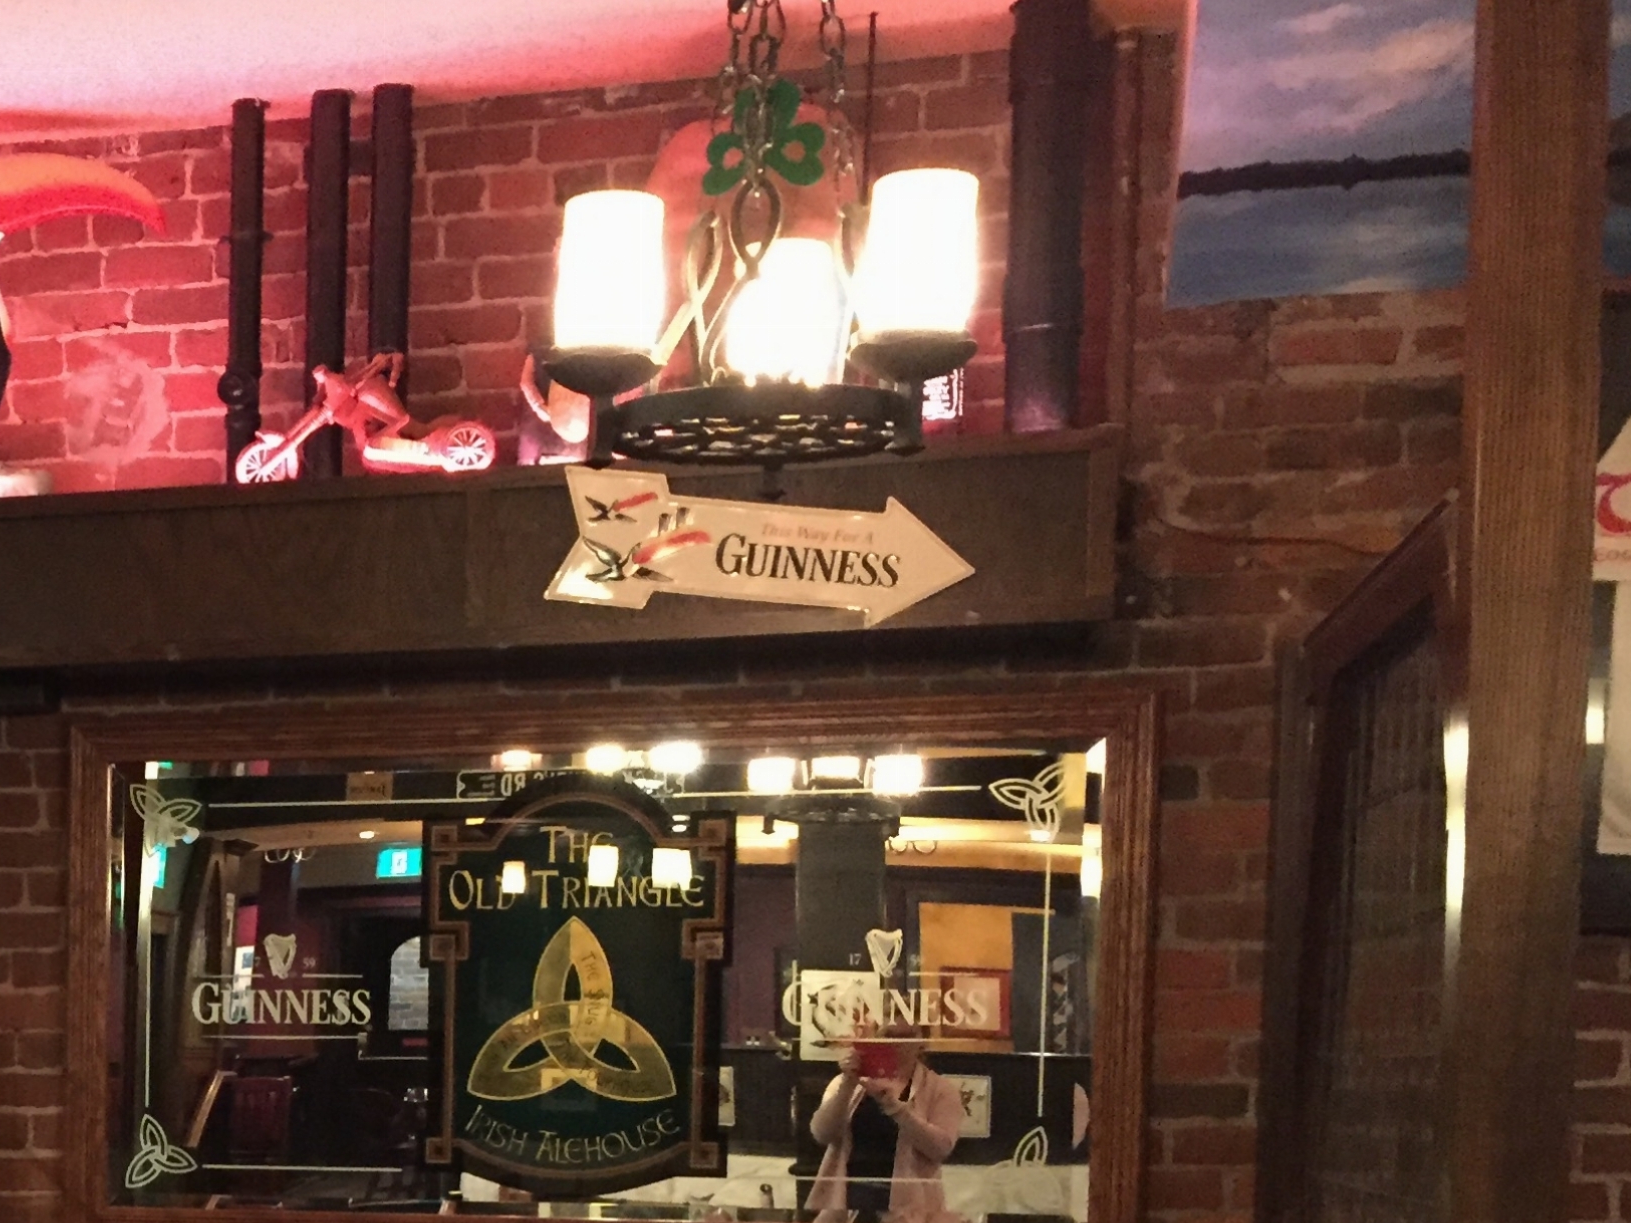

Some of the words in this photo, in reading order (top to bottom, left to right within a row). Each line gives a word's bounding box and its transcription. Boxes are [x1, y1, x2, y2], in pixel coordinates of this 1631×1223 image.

[797, 525, 828, 543] Way
[834, 529, 860, 543] For
[714, 532, 901, 589] GUINNESS
[531, 869, 705, 910] TRIANGLE
[191, 981, 372, 1026] GUINNESS
[465, 1104, 529, 1157] IRISH
[535, 1108, 681, 1165] ALEHOUSE
